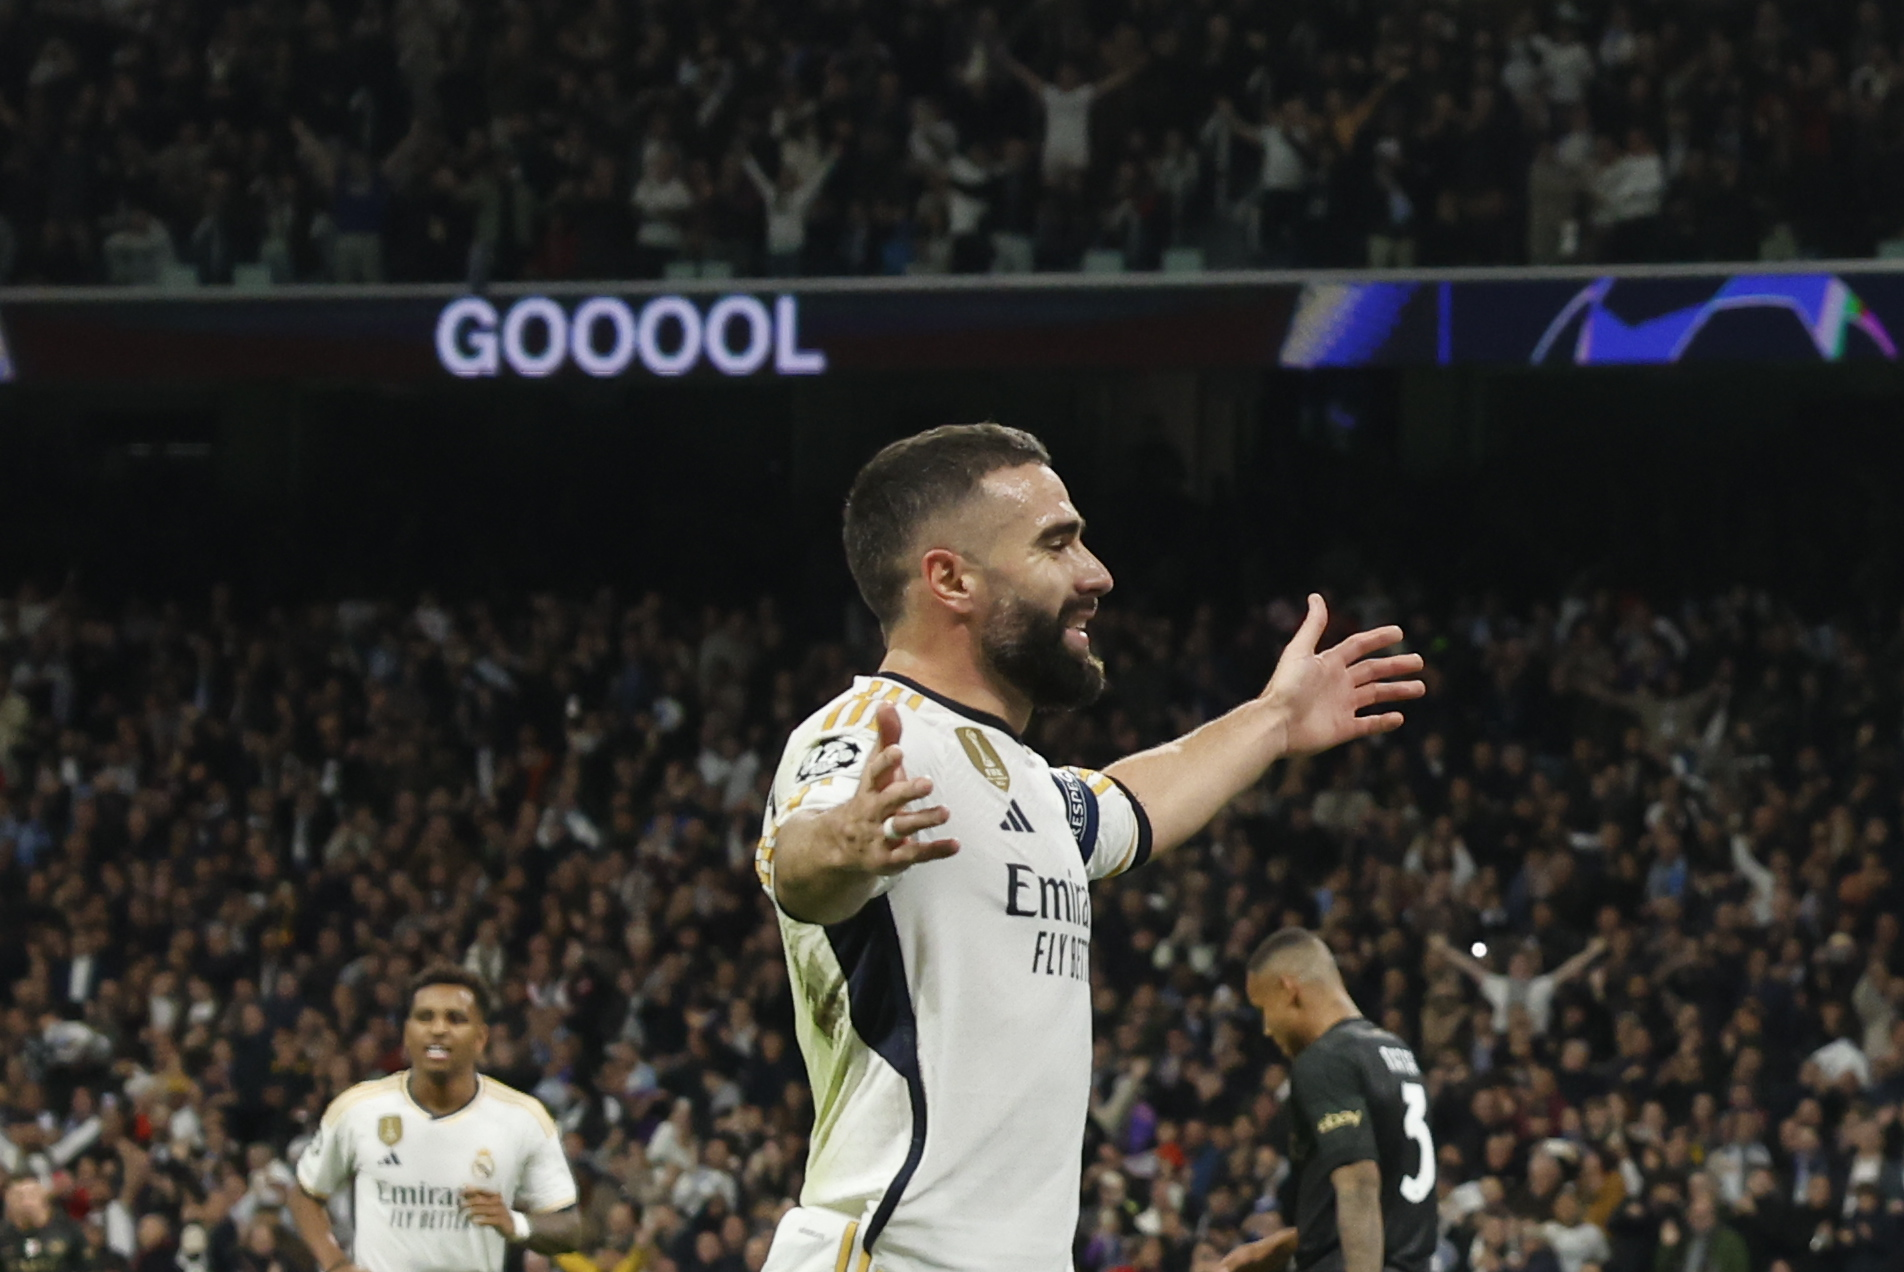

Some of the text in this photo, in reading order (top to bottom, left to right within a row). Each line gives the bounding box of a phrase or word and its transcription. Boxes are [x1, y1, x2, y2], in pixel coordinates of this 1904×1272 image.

[436, 295, 827, 377] GOOOOL
[1032, 930, 1068, 976] FLY
[1400, 1081, 1436, 1203] 3
[376, 1179, 462, 1208] Emira
